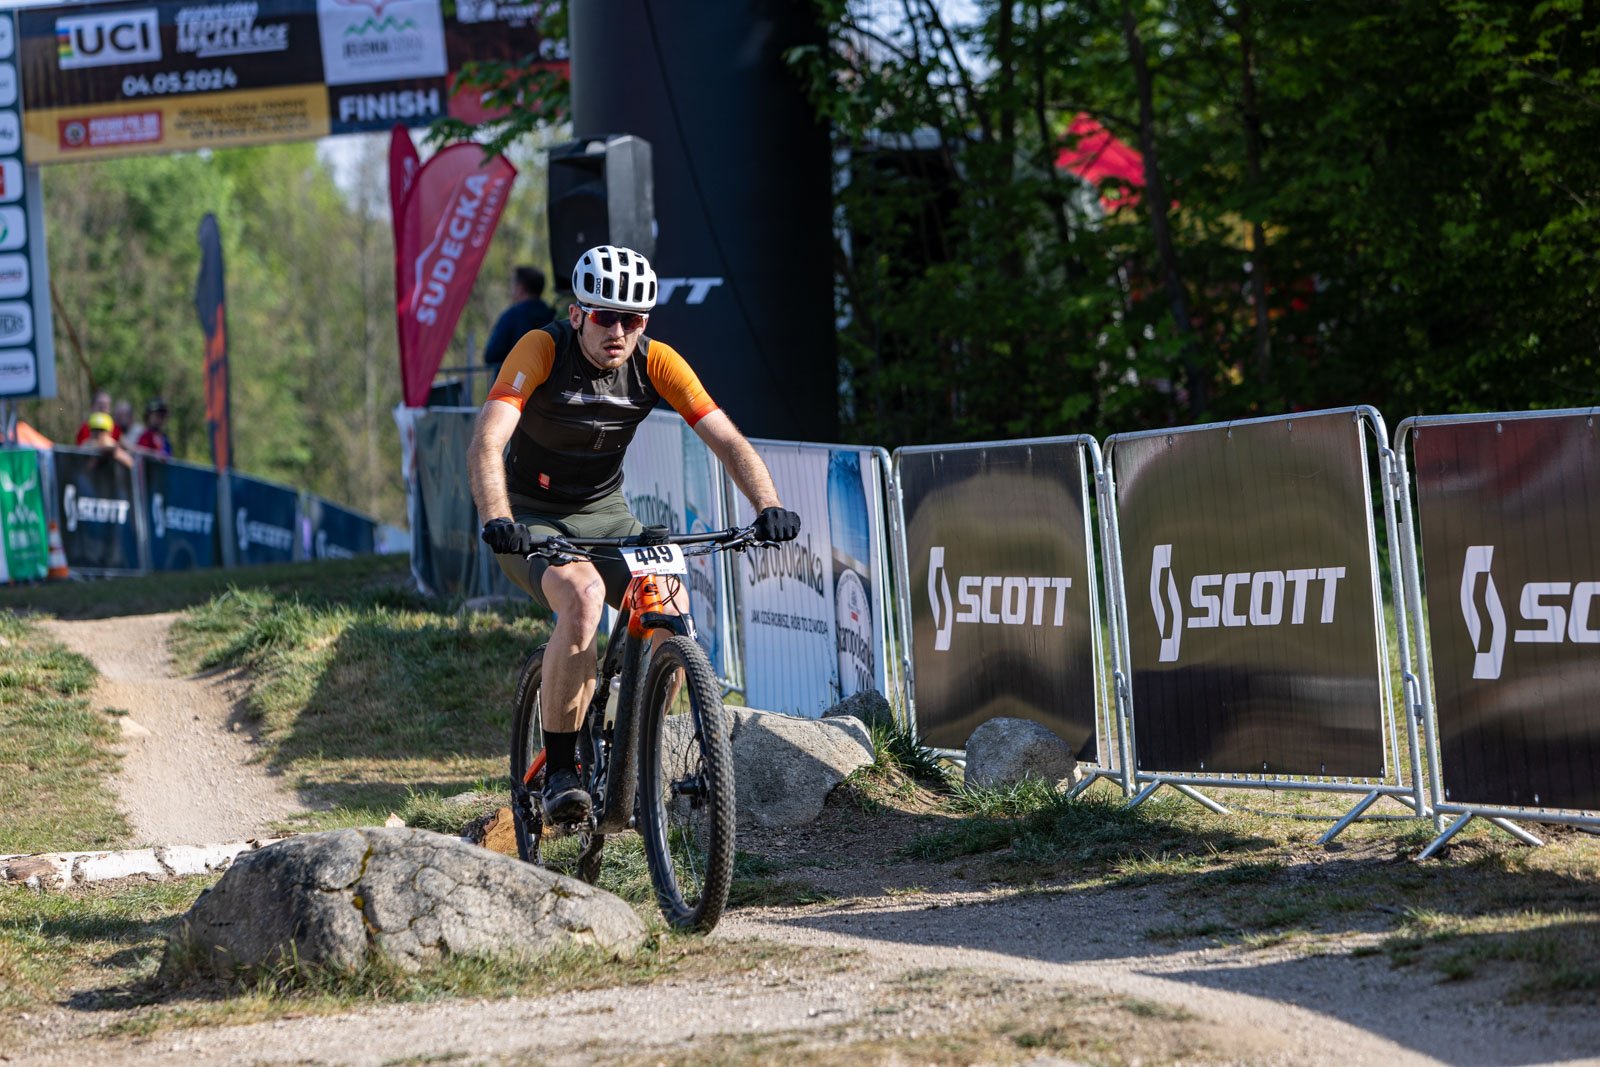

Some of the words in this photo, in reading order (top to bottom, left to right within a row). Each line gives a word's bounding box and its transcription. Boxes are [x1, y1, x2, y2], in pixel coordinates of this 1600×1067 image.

[74, 22, 150, 56] UCI
[121, 67, 238, 97] 04.05.2024
[338, 87, 440, 123] FINISH
[416, 173, 489, 326] SUDECKA
[78, 496, 131, 525] SCOTT
[166, 506, 214, 535] SCOTT
[634, 545, 674, 566] 449
[748, 533, 825, 598] Staropolanka
[956, 575, 1073, 628] SCOTT
[1186, 566, 1347, 629] SCOTT
